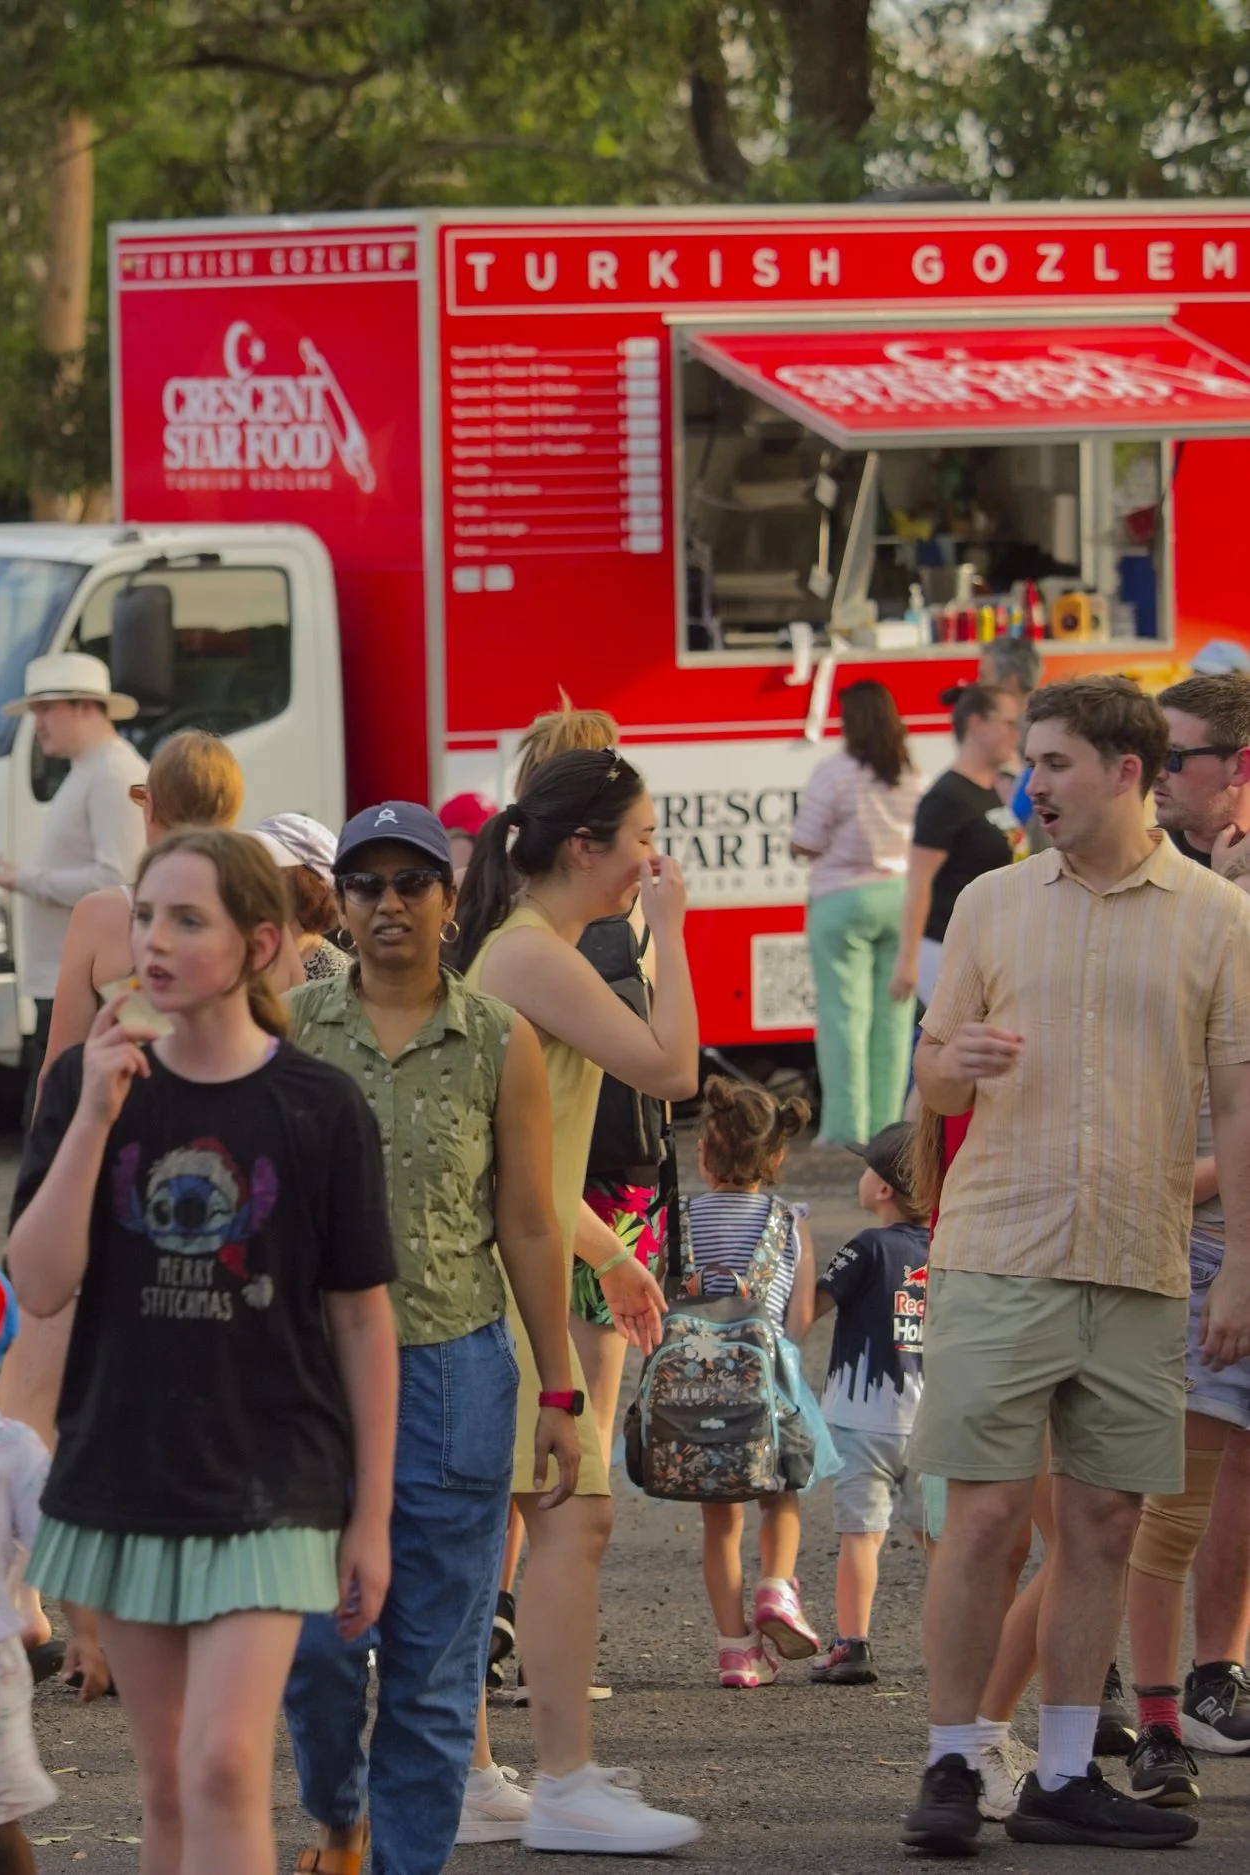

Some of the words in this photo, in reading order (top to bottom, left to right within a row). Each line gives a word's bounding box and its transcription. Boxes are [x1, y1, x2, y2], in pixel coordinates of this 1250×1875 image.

[135, 250, 254, 279] TURKISH
[465, 248, 841, 292] TURKISH
[911, 241, 1238, 284] GOZLEM
[162, 376, 326, 424] CRESCENT
[162, 424, 242, 471] STAR
[245, 423, 332, 470] FOOD
[652, 790, 802, 829] RESC
[654, 832, 745, 869] TAR
[156, 1255, 216, 1286] MERRY
[139, 1286, 234, 1321] STITCHMAS
[670, 1386, 710, 1401] NAME
